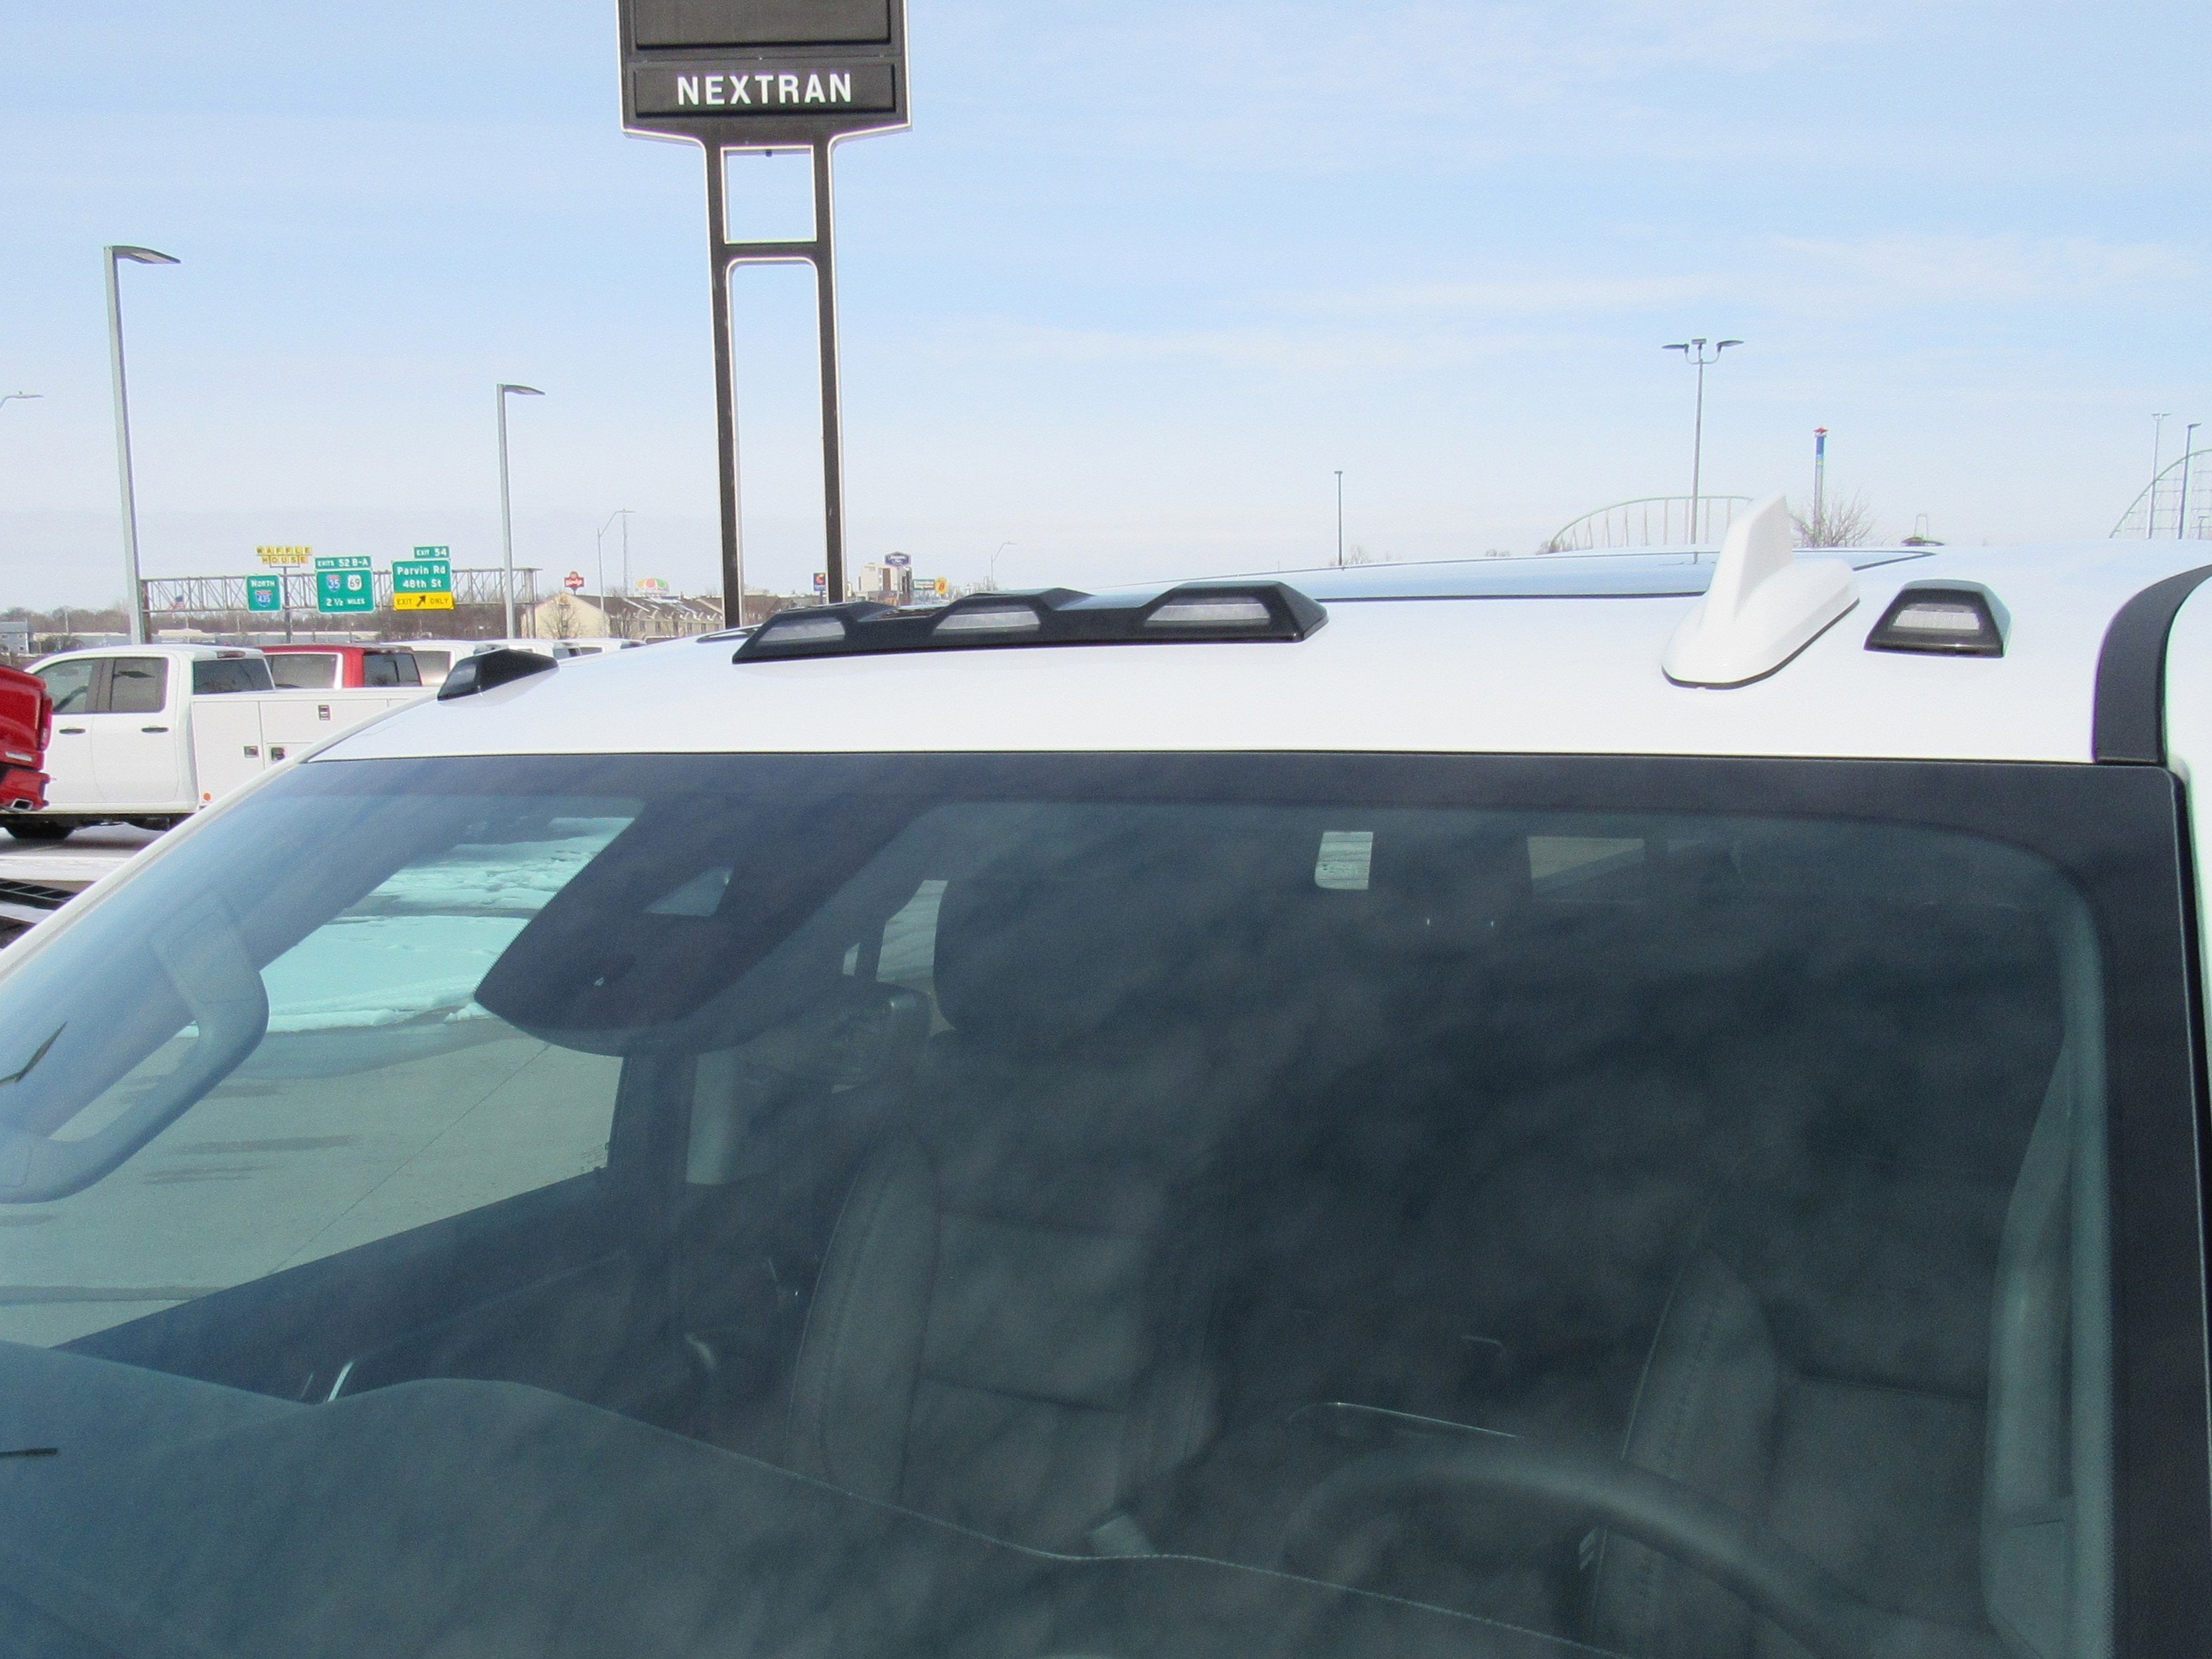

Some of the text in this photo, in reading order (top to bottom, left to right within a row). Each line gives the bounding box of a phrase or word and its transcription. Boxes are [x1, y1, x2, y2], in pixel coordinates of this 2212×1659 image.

[677, 73, 851, 105] NEXTRAN
[339, 558, 350, 567] 52
[397, 565, 446, 576] Parvin Rd
[328, 580, 341, 589] 35
[349, 578, 360, 587] 69
[402, 579, 442, 588] 48th St
[326, 598, 332, 607] 2
